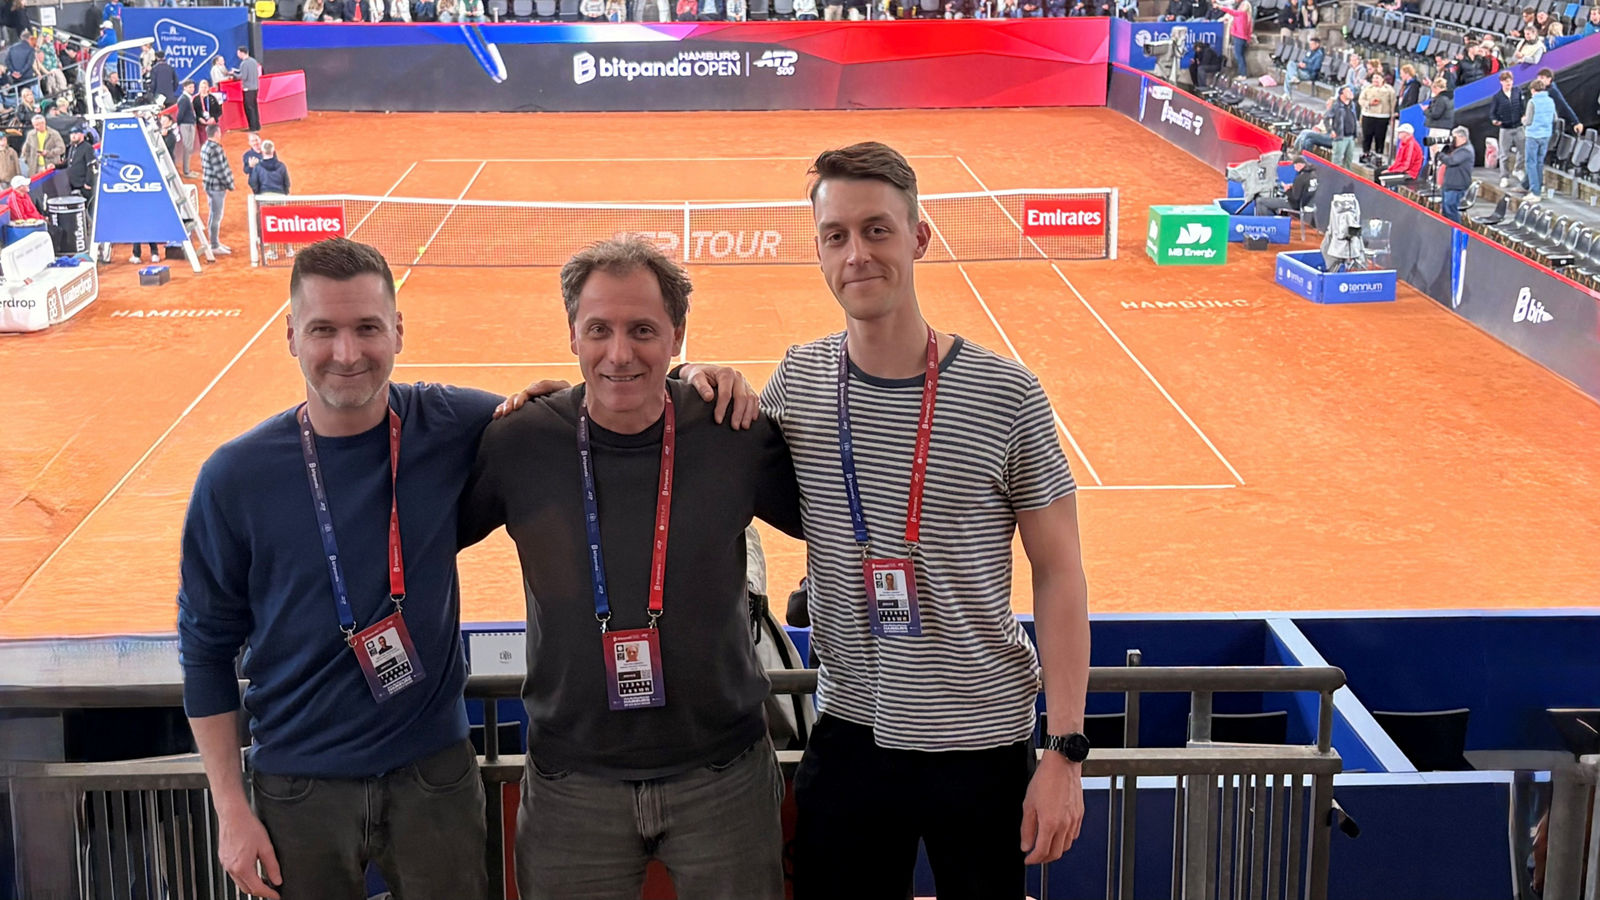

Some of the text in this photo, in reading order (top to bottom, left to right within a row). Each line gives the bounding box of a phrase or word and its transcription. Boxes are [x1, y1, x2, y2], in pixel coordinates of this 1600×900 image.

[165, 45, 207, 56] ACTIVE
[679, 51, 740, 61] HAMBURG
[167, 57, 193, 68] CITY
[599, 57, 692, 81] bitpanda
[694, 61, 741, 76] OPEN
[753, 51, 798, 67] ATP
[102, 182, 163, 193] LEXUS
[1027, 208, 1102, 226] Emirates
[265, 215, 341, 232] Emirates
[692, 230, 782, 258] TOUR
[1168, 248, 1217, 259] MB Energy
[1349, 282, 1383, 292] tennium
[111, 308, 242, 318] HAMBURG
